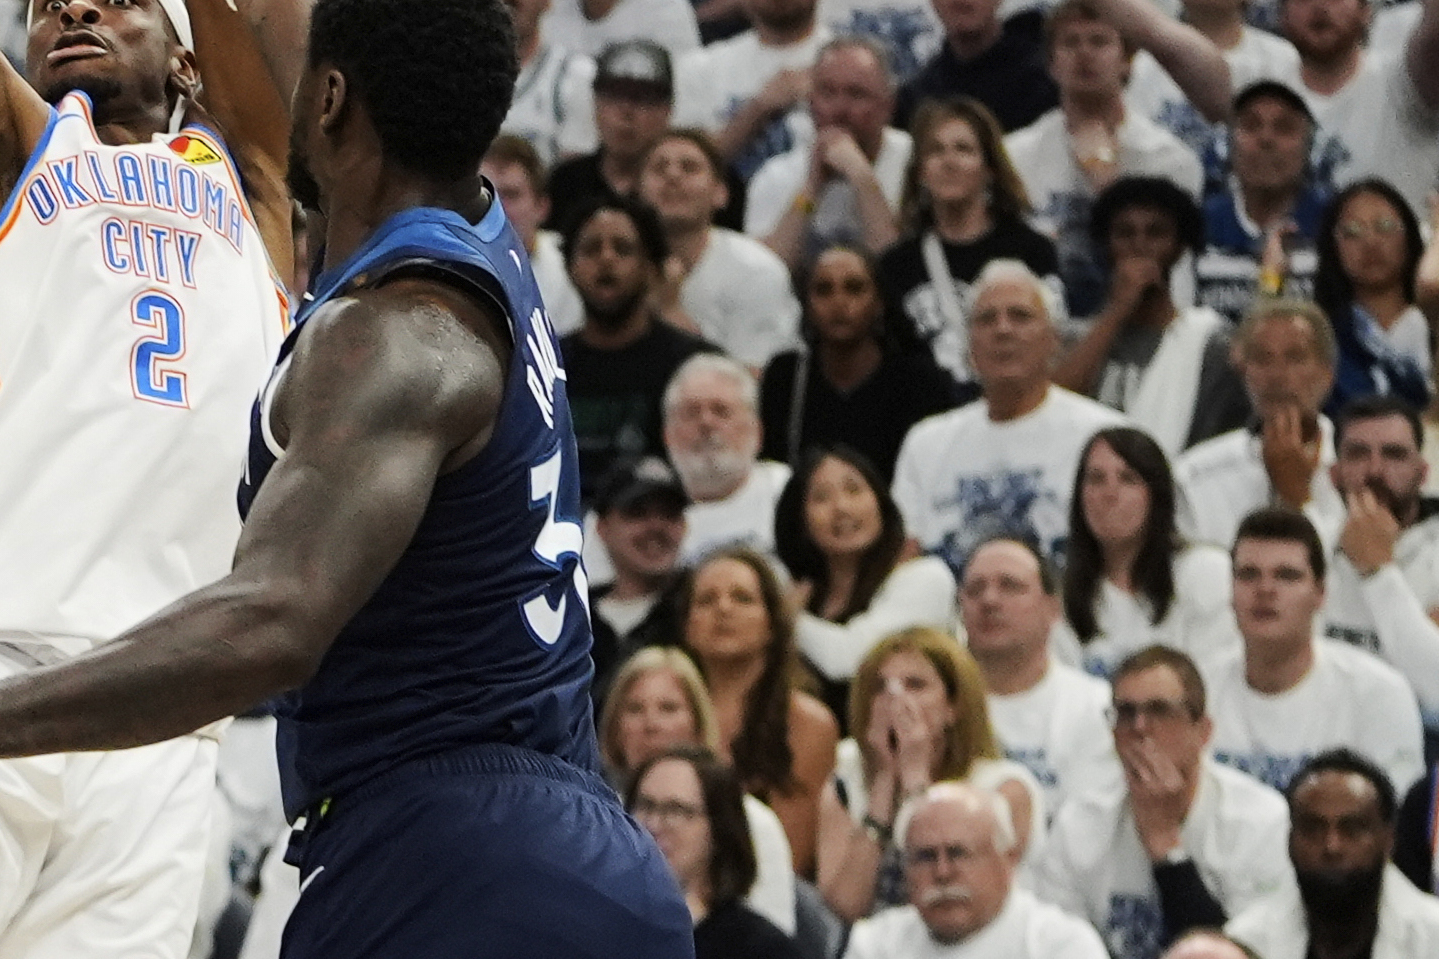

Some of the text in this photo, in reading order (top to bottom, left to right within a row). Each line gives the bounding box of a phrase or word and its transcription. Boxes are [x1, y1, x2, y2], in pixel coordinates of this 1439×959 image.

[24, 151, 244, 256] OKLAHOMA
[101, 217, 202, 289] CITY
[130, 290, 191, 409] 2
